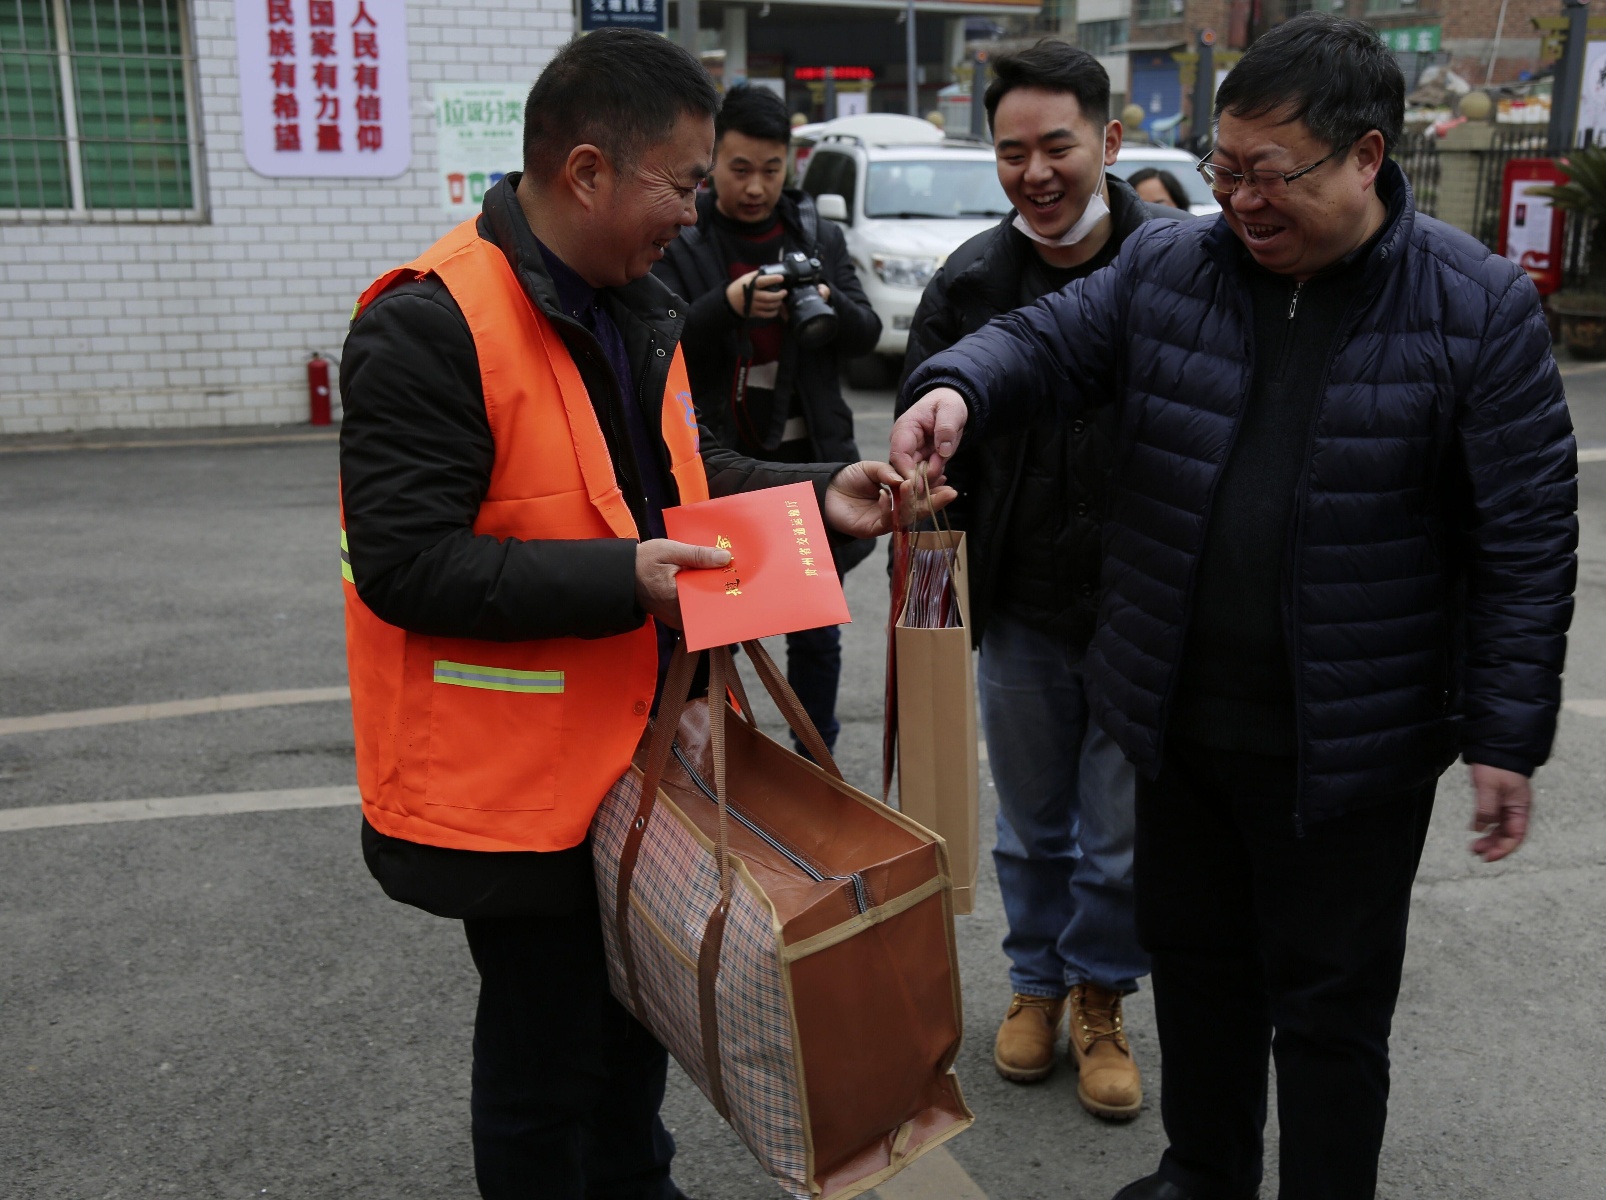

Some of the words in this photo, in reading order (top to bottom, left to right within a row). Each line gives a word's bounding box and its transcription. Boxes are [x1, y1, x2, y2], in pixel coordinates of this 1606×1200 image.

[267, 0, 302, 152] 民族有希望
[309, 0, 342, 152] 国家有力量
[351, 0, 382, 152] 人民有信仰
[444, 97, 522, 127] 垃圾分类
[785, 500, 818, 576] 贵州省交通运输厅
